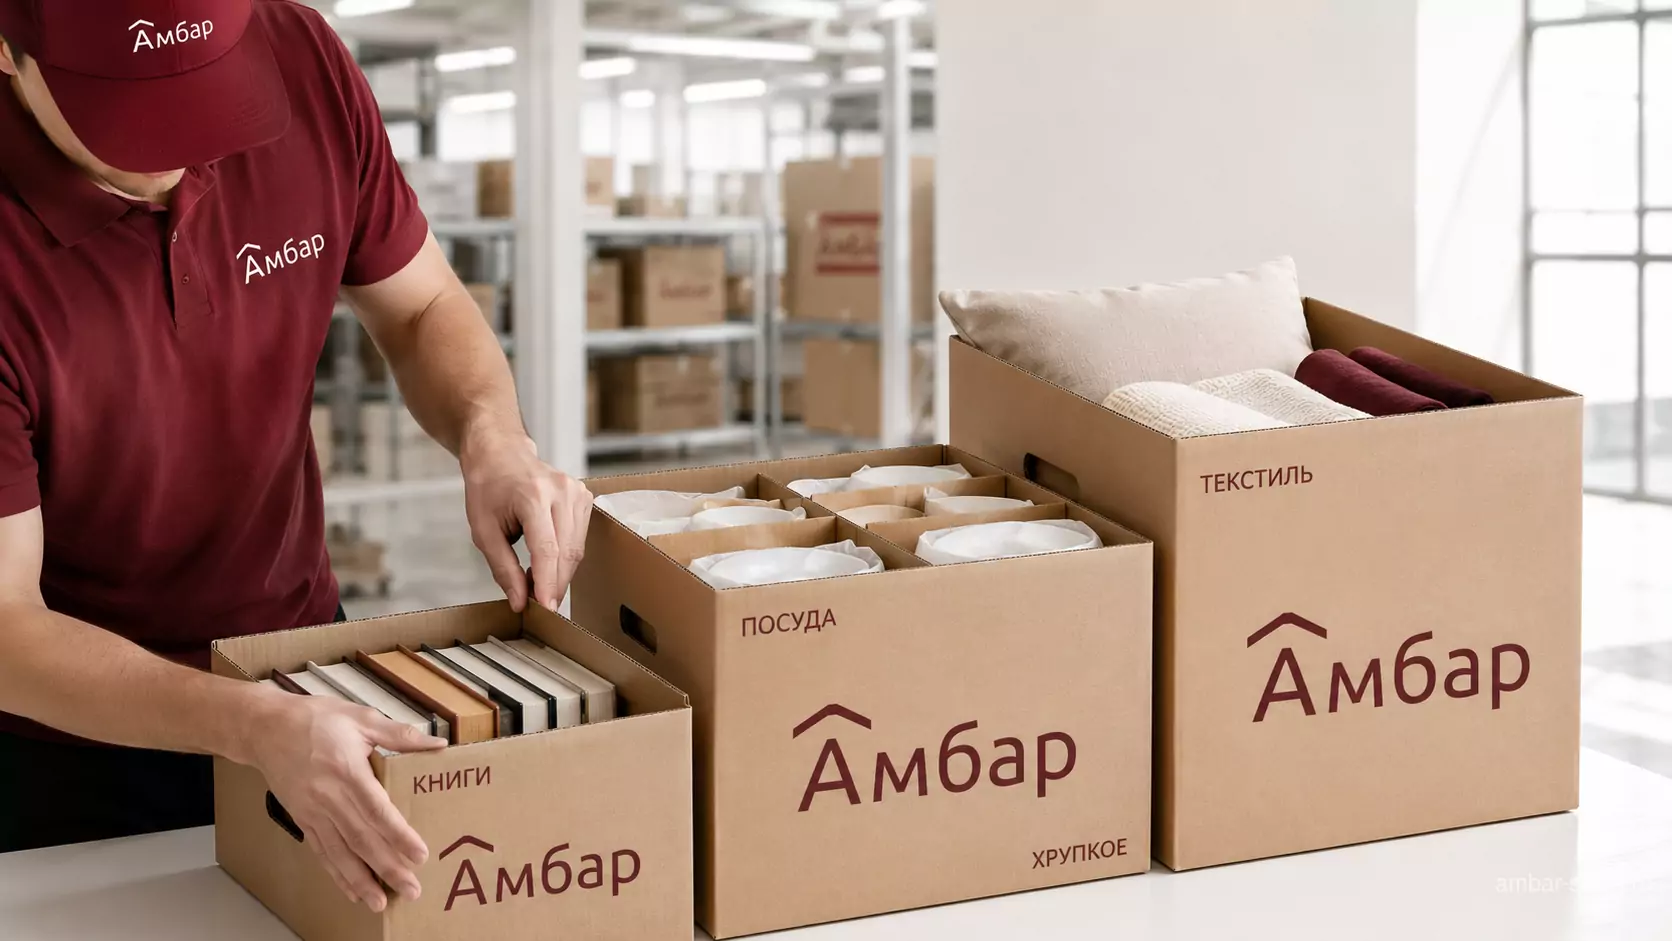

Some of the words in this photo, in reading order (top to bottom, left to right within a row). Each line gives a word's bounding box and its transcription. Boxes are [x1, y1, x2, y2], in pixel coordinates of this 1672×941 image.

[128, 19, 214, 53] Амбар
[236, 233, 325, 285] Амбар
[1200, 465, 1313, 494] ТЕКСТИЛЬ
[742, 608, 837, 637] ПОСУДА
[1247, 611, 1531, 723] Амбар
[792, 703, 1077, 813] Амбар
[413, 765, 491, 795] КНИГИ
[1032, 838, 1127, 870] ХРУПКОЕ
[438, 834, 641, 912] Амбар
